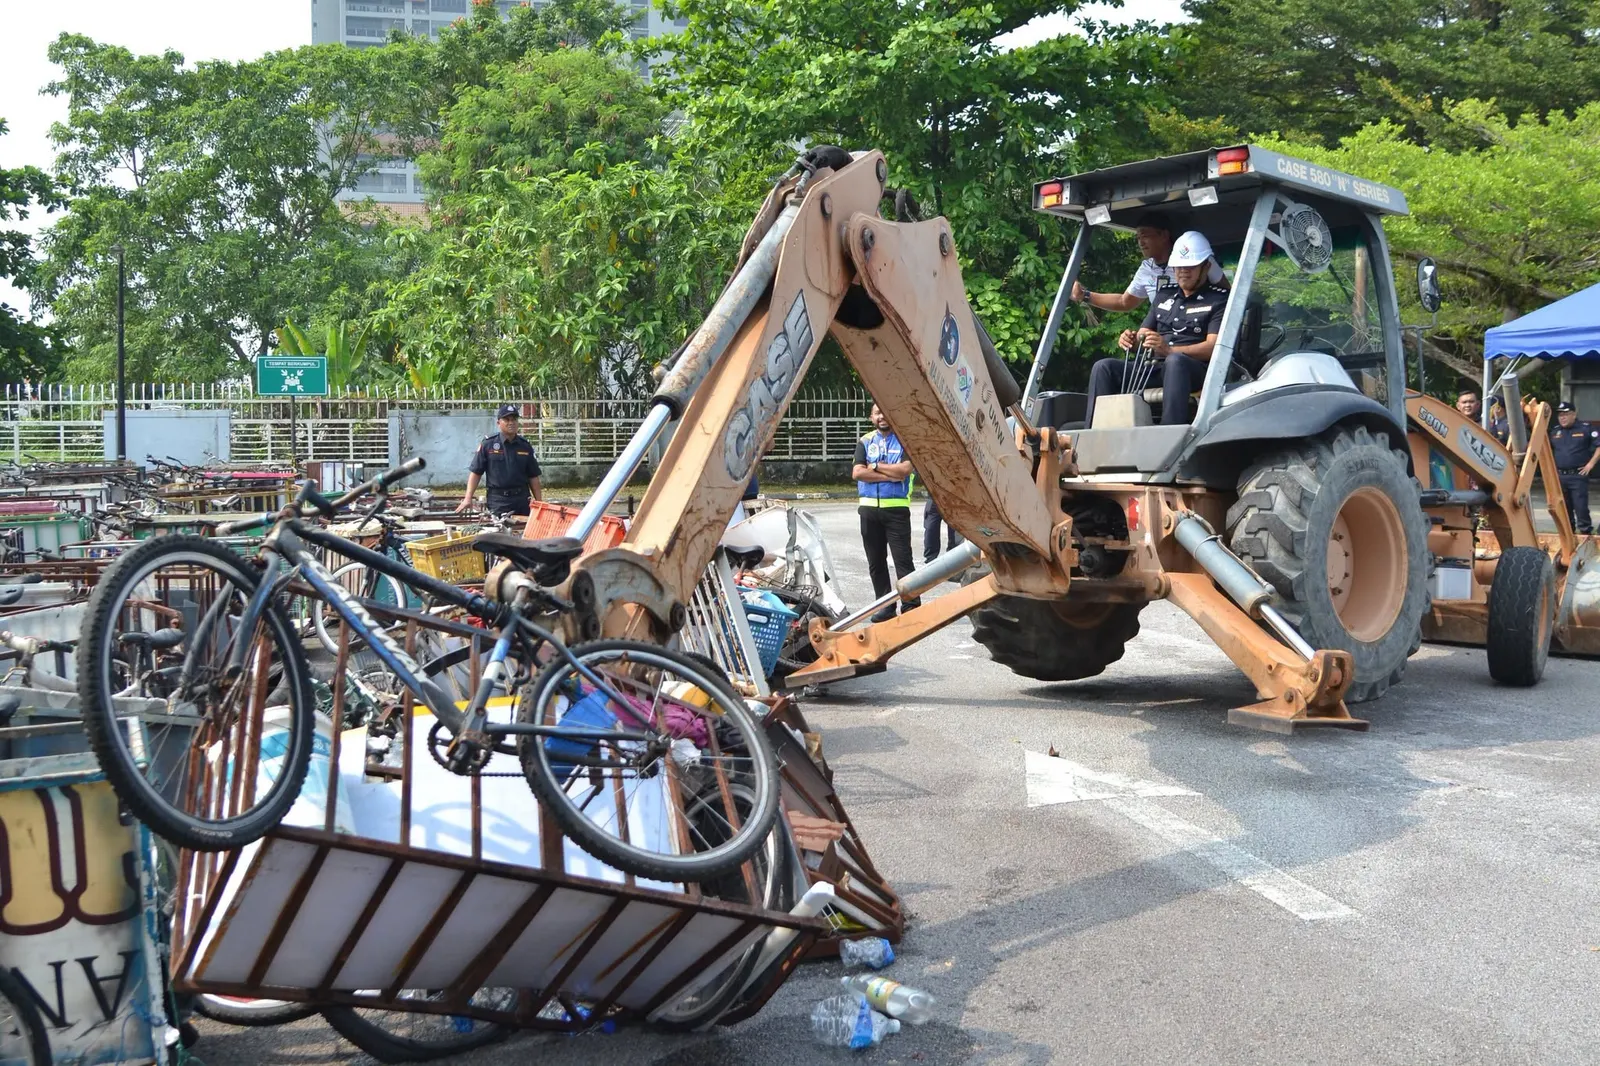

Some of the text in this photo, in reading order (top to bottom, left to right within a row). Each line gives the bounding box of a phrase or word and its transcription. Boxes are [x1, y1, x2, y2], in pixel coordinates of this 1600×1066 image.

[1276, 158, 1308, 181] CASE
[1310, 167, 1332, 188] 580
[1353, 180, 1390, 204] SERIES
[723, 288, 815, 482] CASE
[988, 403, 1005, 447] UMW
[1417, 405, 1449, 439] 580M
[1461, 427, 1506, 473] CASE
